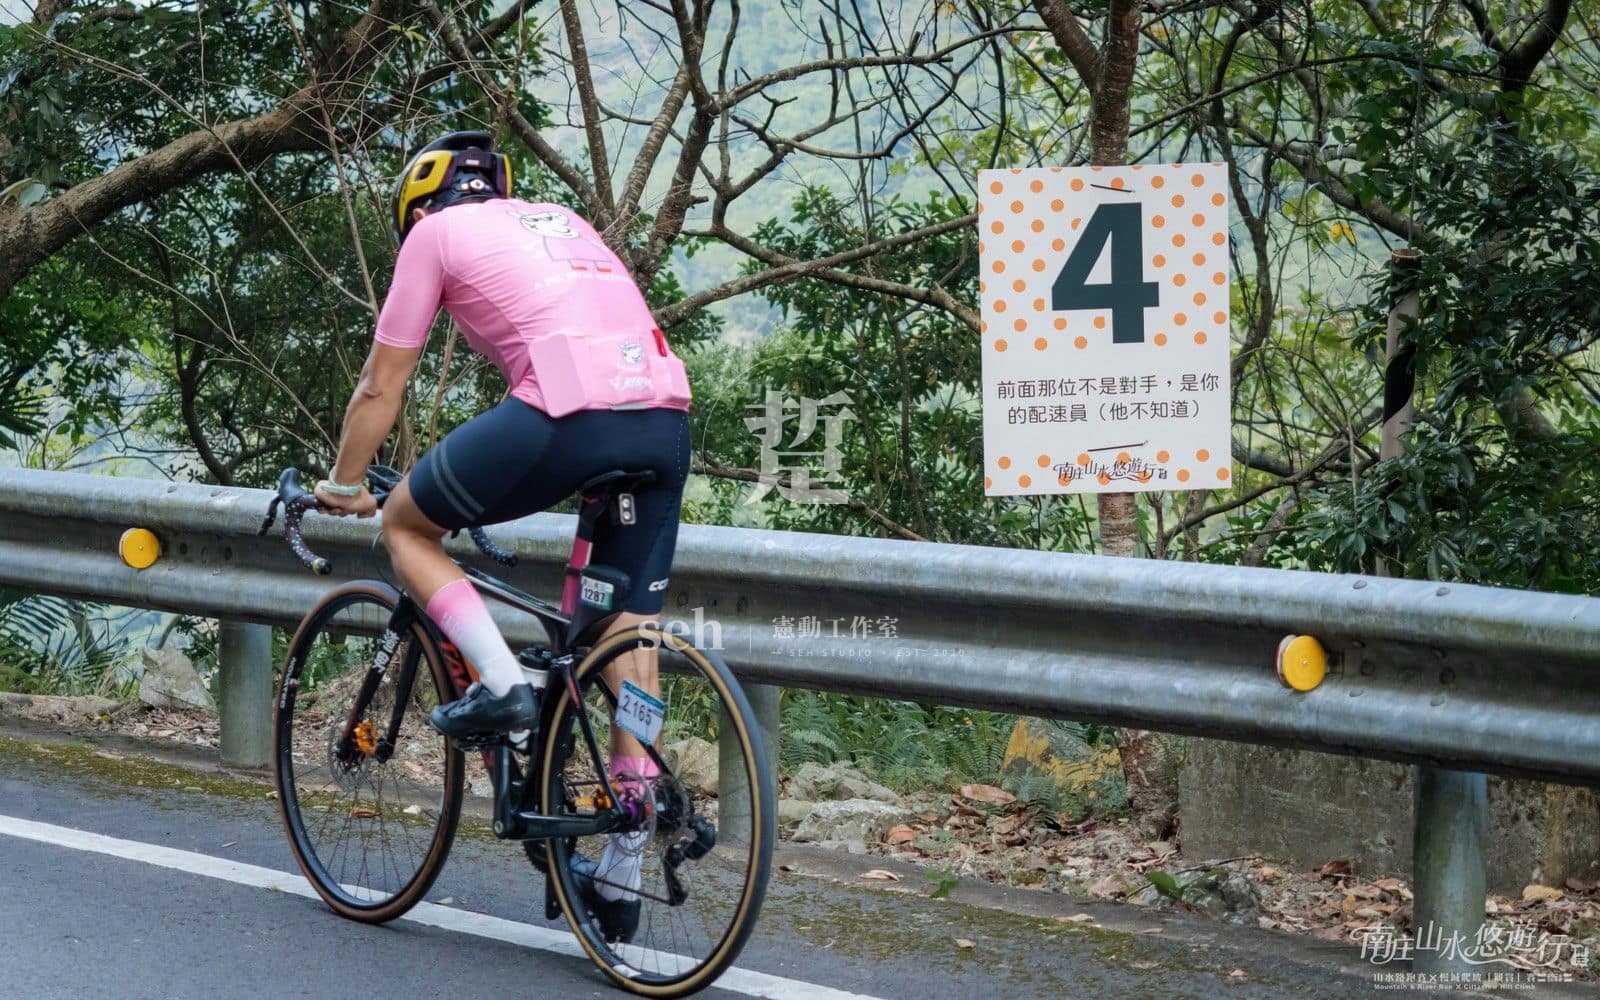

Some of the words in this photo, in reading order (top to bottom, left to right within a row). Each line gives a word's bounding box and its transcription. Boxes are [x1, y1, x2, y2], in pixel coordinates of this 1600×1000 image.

[1052, 202, 1160, 344] 4
[997, 373, 1219, 399] 前面那位不是對手，是你
[1008, 399, 1201, 425] 的配速員（他不知道）
[584, 588, 605, 603] 1287
[622, 695, 652, 726] 2165
